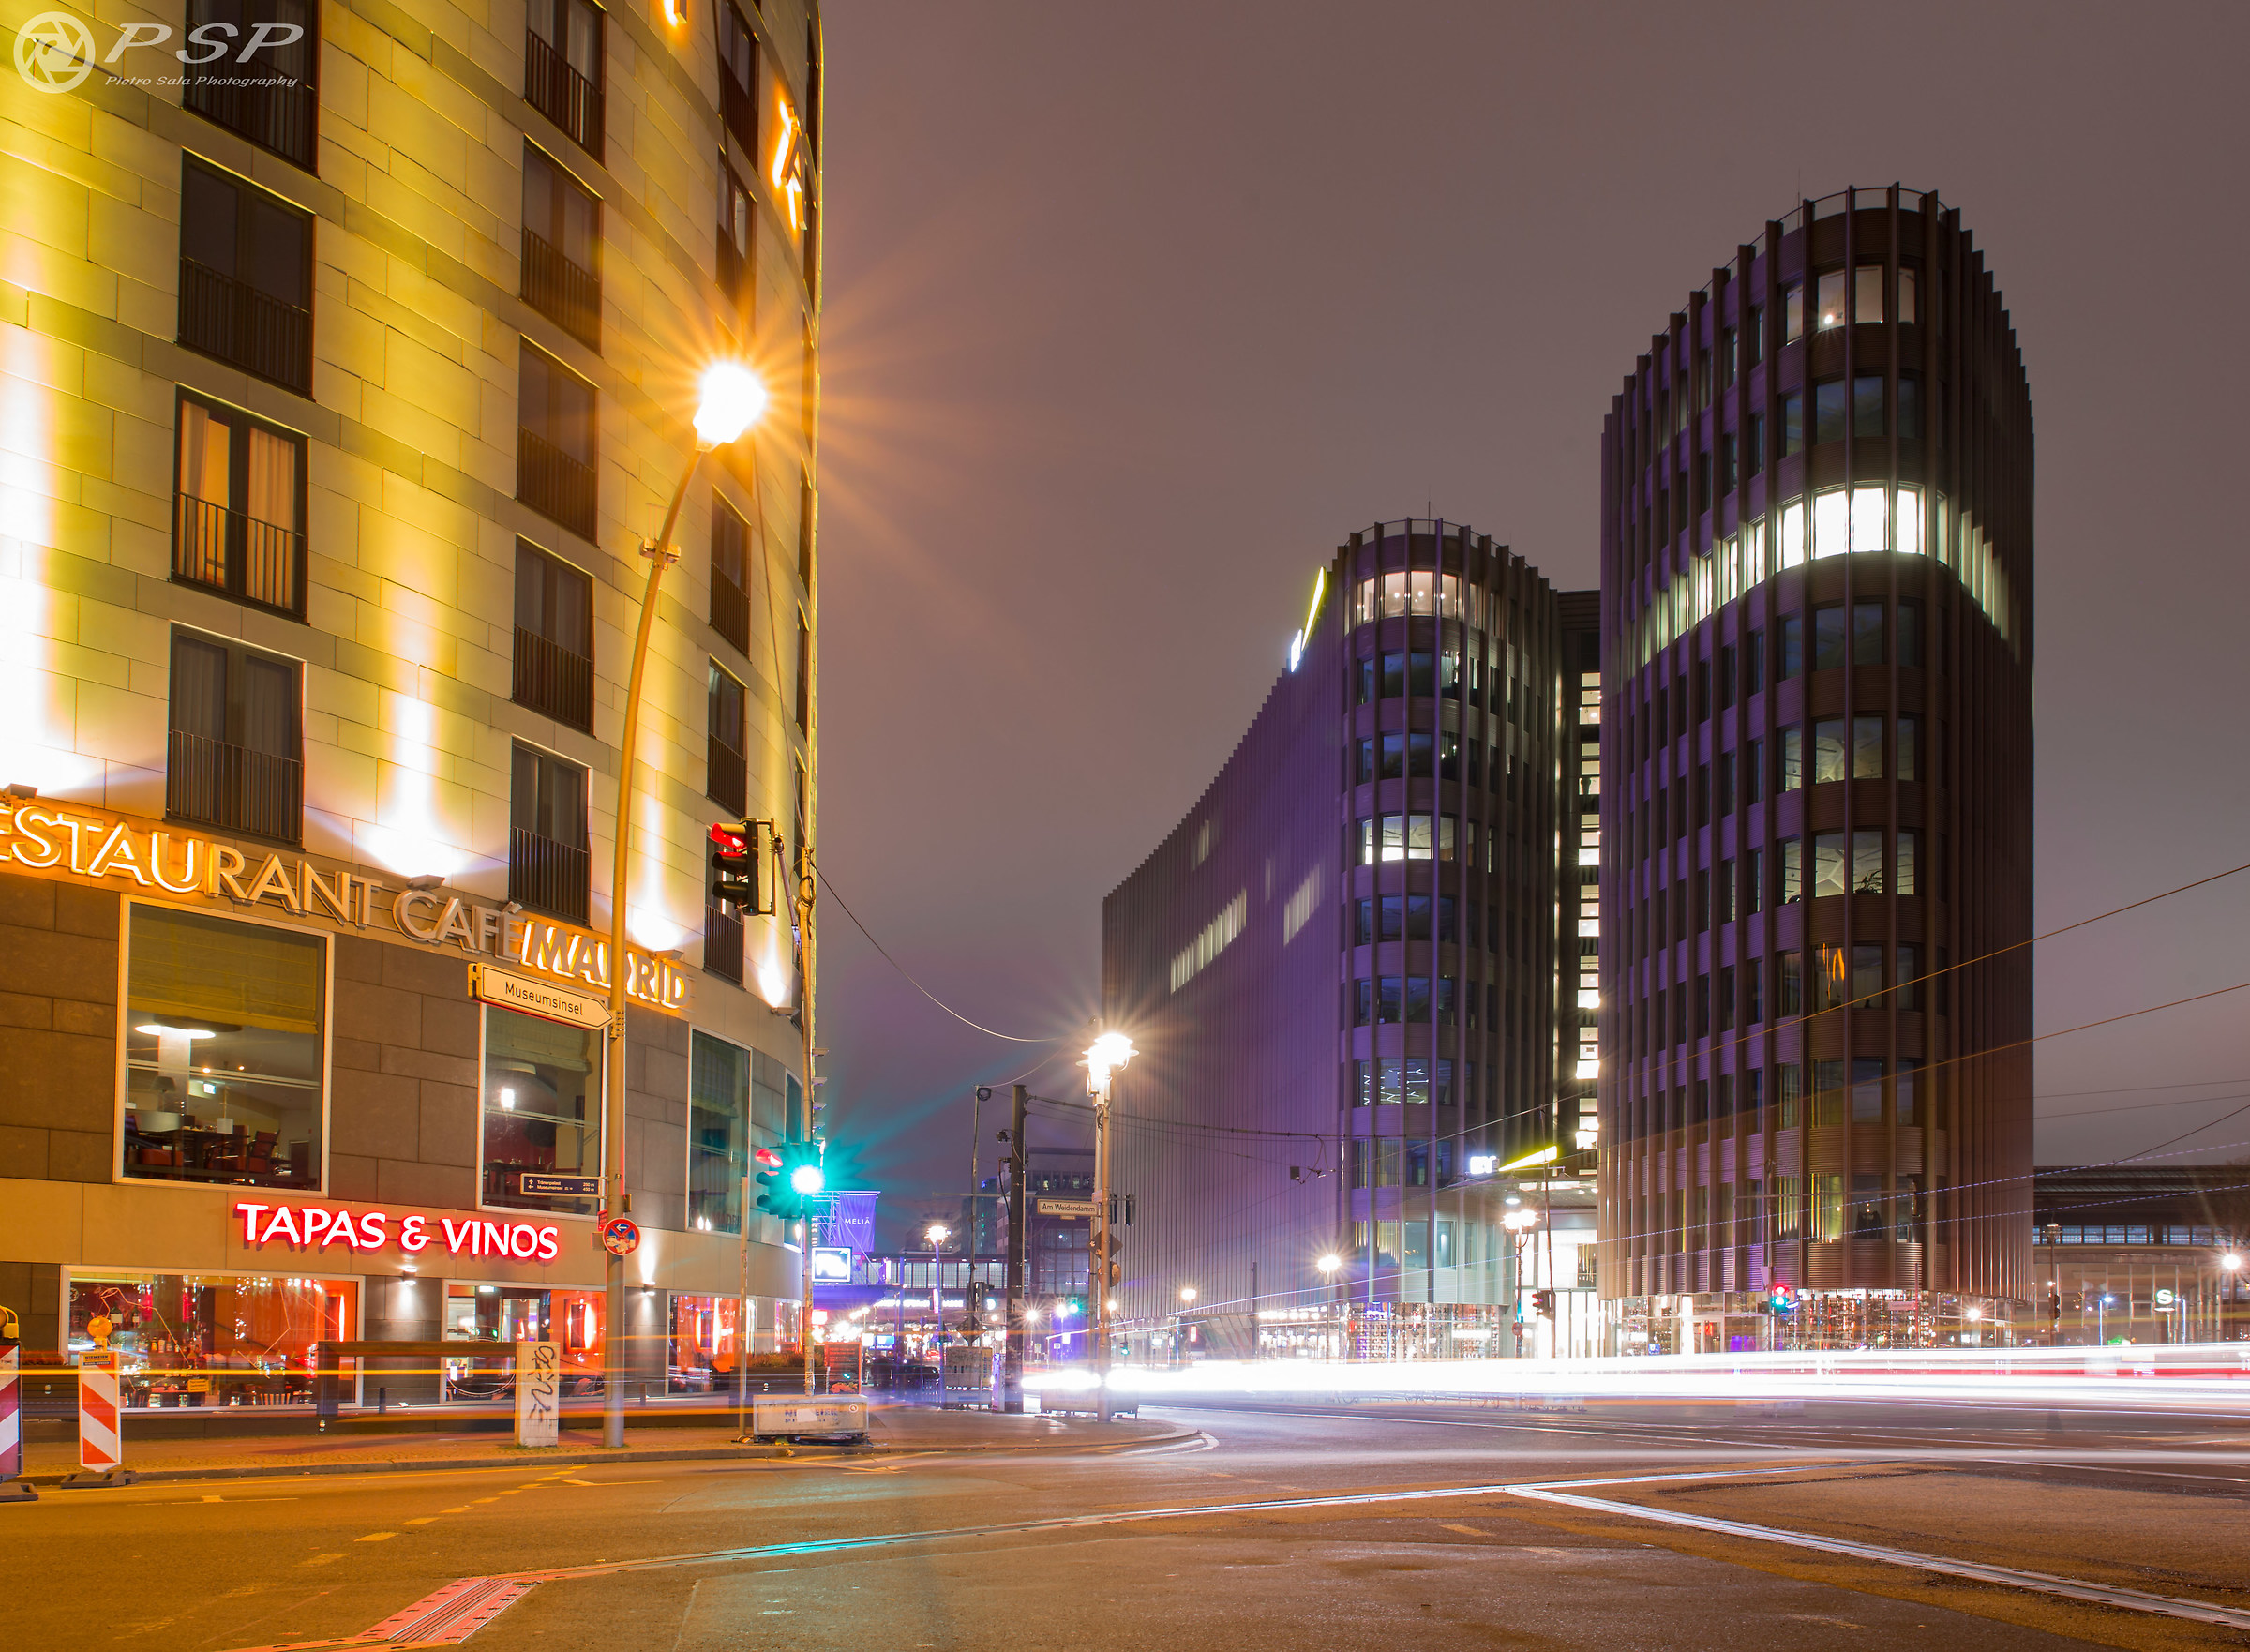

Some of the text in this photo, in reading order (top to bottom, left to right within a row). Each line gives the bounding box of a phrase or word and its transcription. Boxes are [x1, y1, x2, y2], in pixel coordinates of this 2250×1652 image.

[505, 982, 582, 1015] Museumsinsel
[1055, 1203, 1095, 1212] Weidendamm
[236, 1203, 559, 1260] TAPAS & VINOS
[2156, 1289, 2174, 1304] S
